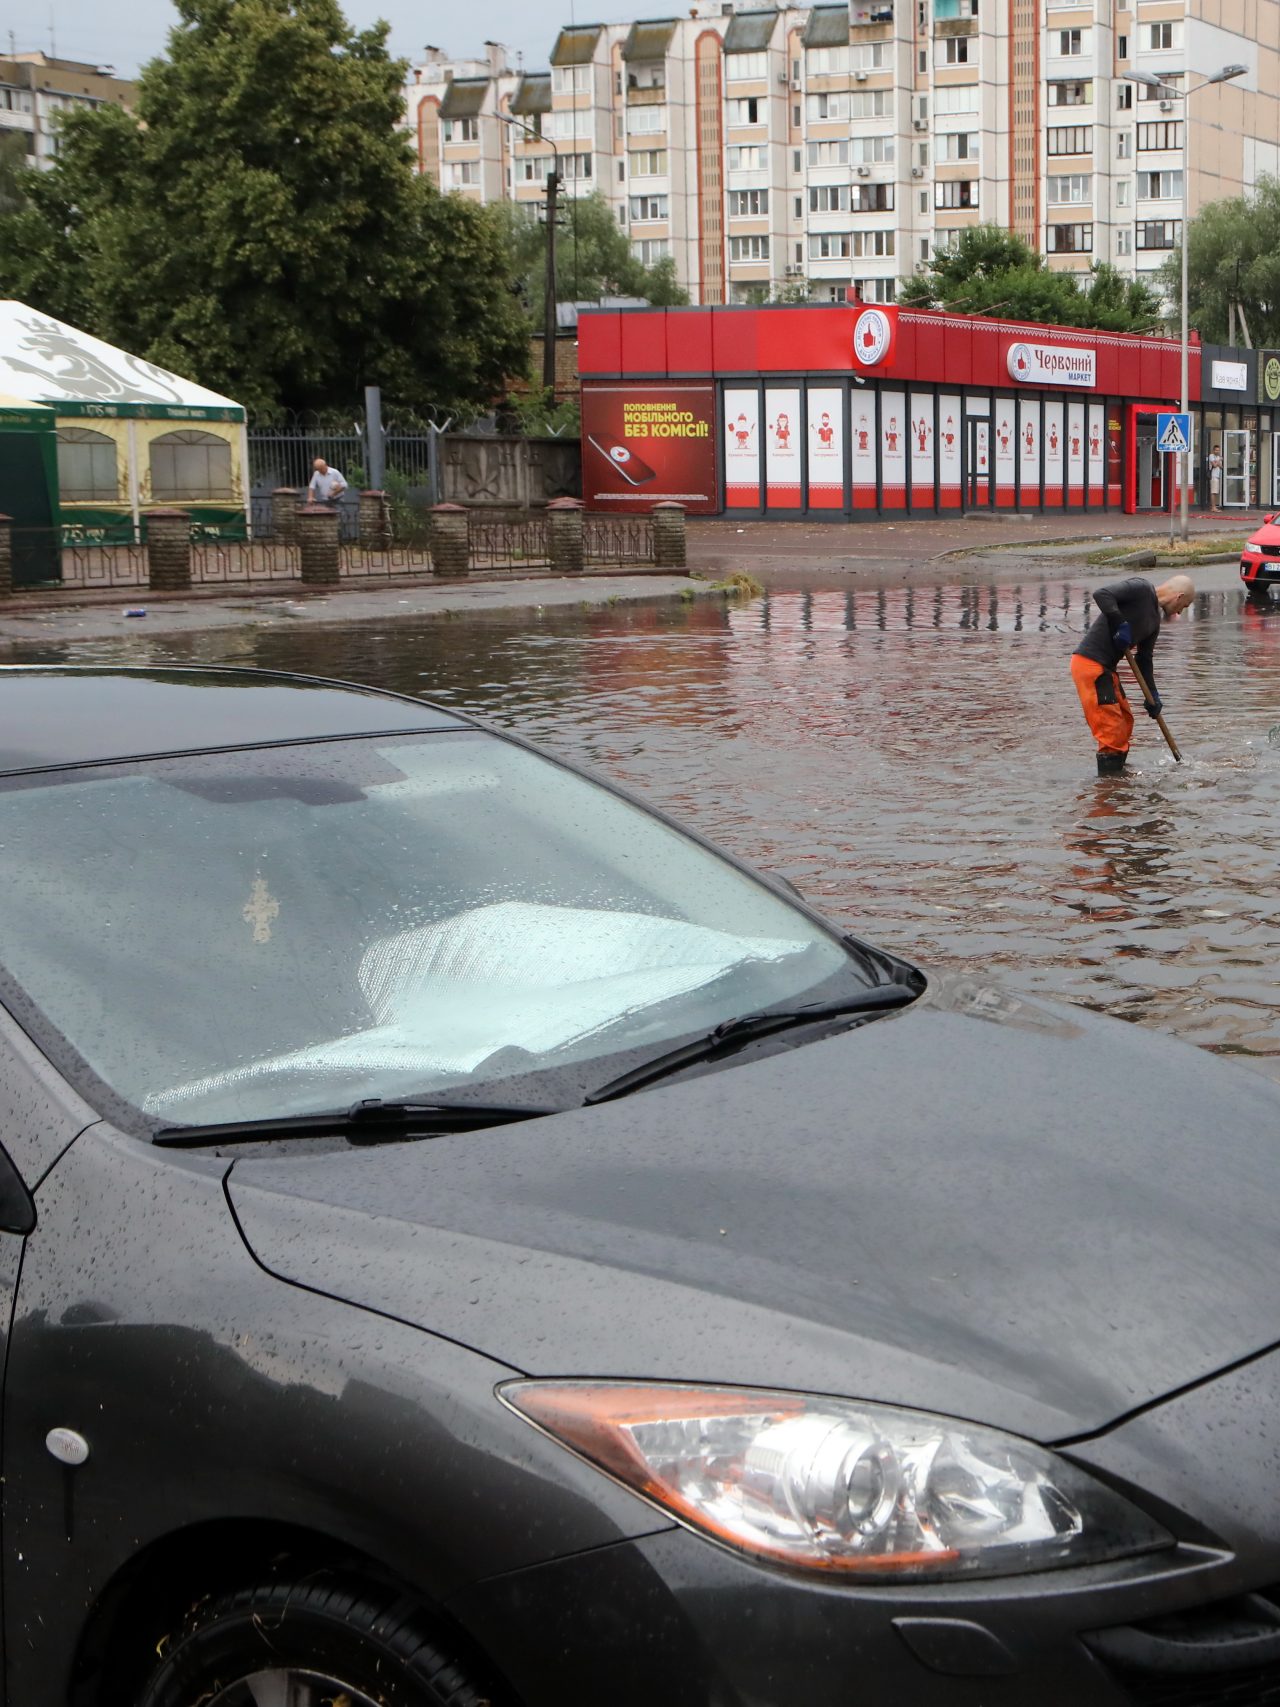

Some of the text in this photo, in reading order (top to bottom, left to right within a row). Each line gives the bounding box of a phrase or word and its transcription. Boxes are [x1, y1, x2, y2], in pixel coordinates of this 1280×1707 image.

[1034, 349, 1092, 376] Червоний
[1068, 372, 1091, 382] МАРКЕТ
[624, 403, 677, 411] ПОПОВНЕННЯ
[624, 412, 694, 422] МОБІЛЬНОГО
[625, 421, 709, 437] БЕЗ КОМІСІЇ!
